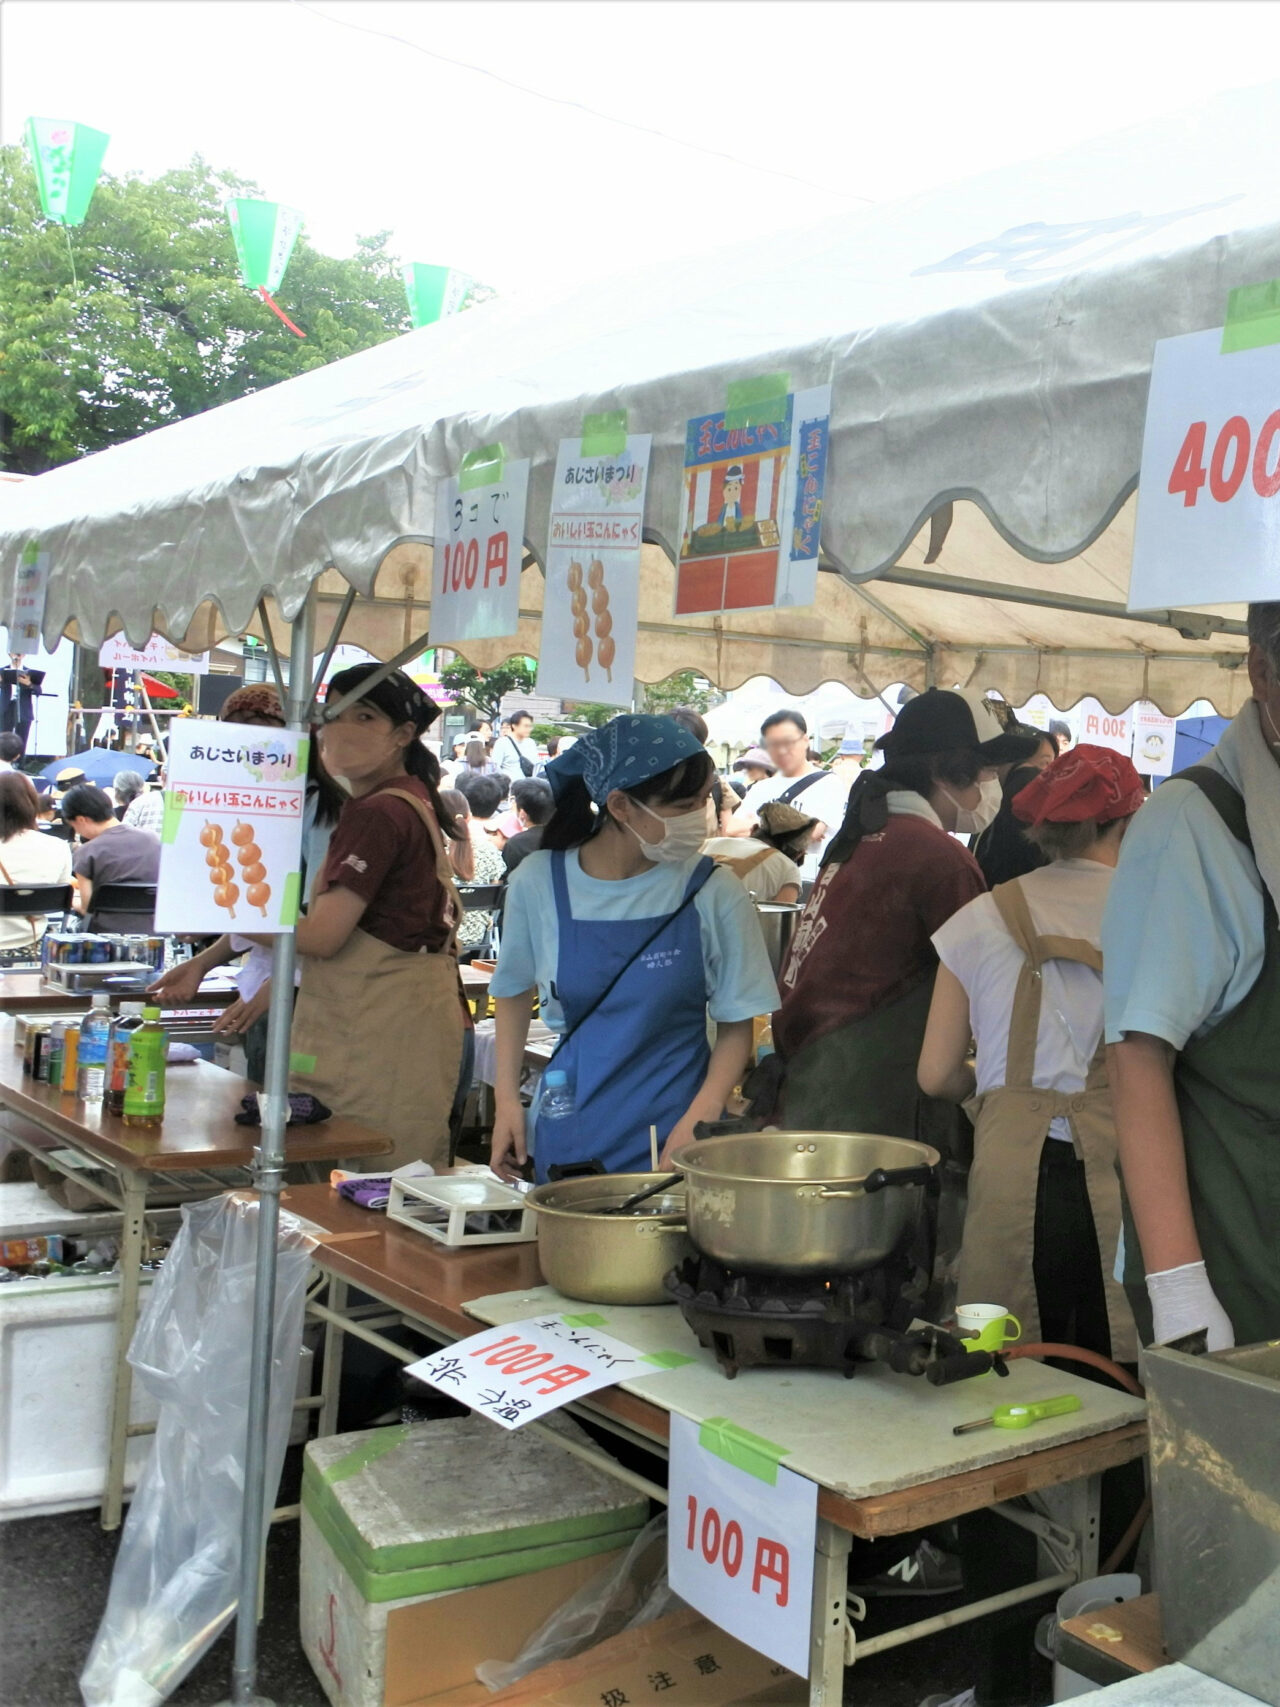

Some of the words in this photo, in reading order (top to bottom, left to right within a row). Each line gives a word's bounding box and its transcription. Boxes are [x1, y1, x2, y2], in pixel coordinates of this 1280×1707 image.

[565, 464, 635, 485] あじさいまつり
[800, 428, 822, 554] 玉こんにゃく
[552, 521, 638, 540] おいしい玉こんにゃく
[442, 531, 509, 594] 100円
[190, 745, 292, 768] あじさいまつり
[175, 789, 299, 810] おいしい玉こんにゃく
[468, 1335, 591, 1395] 100円
[687, 1494, 790, 1608] 100円
